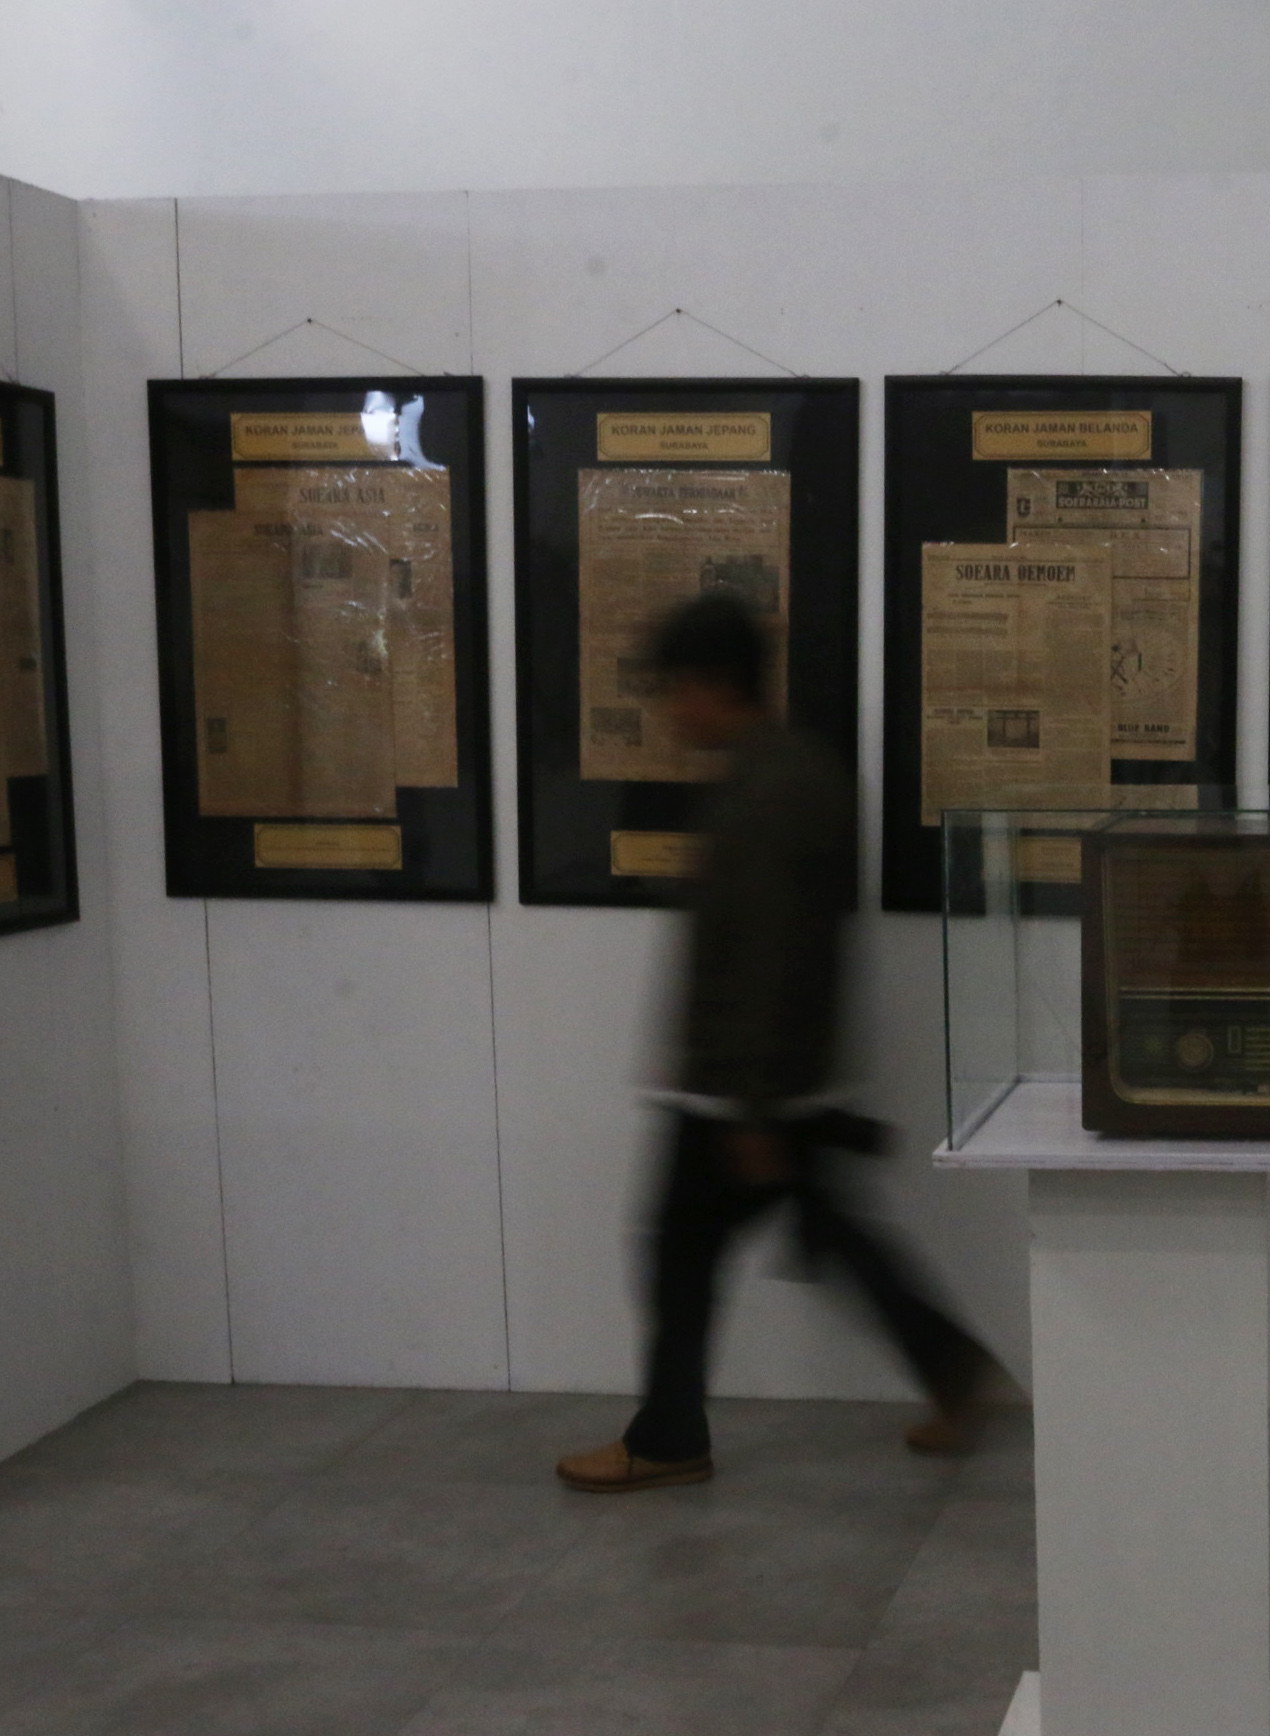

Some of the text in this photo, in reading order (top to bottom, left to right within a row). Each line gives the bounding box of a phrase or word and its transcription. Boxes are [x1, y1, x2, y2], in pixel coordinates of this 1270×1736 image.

[245, 425, 288, 436] KORAN
[292, 425, 333, 436] JAMAN
[611, 424, 756, 436] KORAN JAMAN JEPANG
[985, 423, 1138, 434] KORAN JAMAN BELANDA
[659, 441, 708, 449] SURABAYA
[1037, 439, 1087, 447] SURABAYA
[956, 564, 1076, 582] SOEARA OEMOEM
